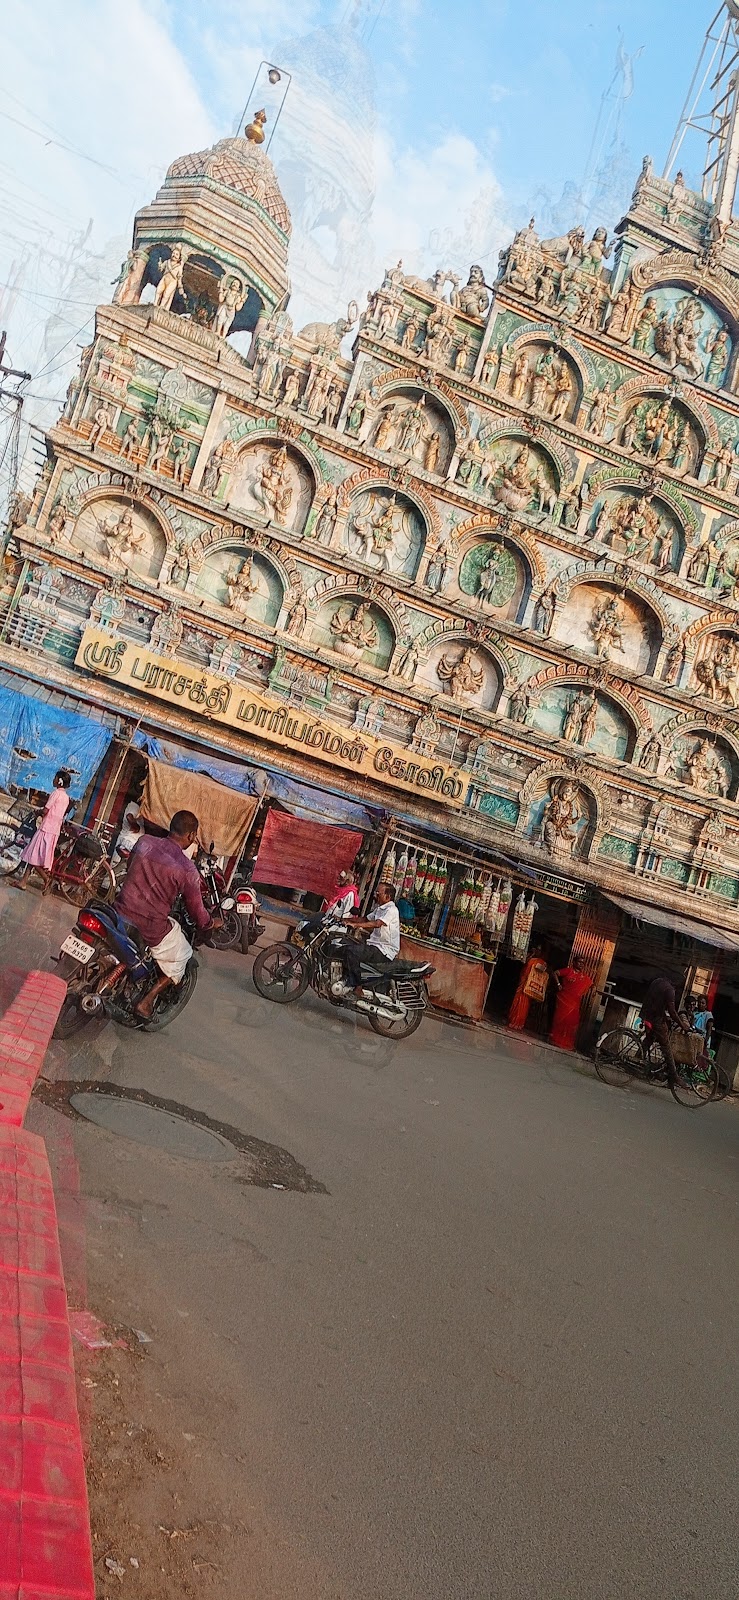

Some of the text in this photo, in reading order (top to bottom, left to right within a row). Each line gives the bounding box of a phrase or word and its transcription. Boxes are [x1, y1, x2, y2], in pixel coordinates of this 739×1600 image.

[130, 656, 233, 715] பராசக்தி
[236, 698, 367, 765] மாரியம்மன்
[373, 745, 464, 800] கோவில்
